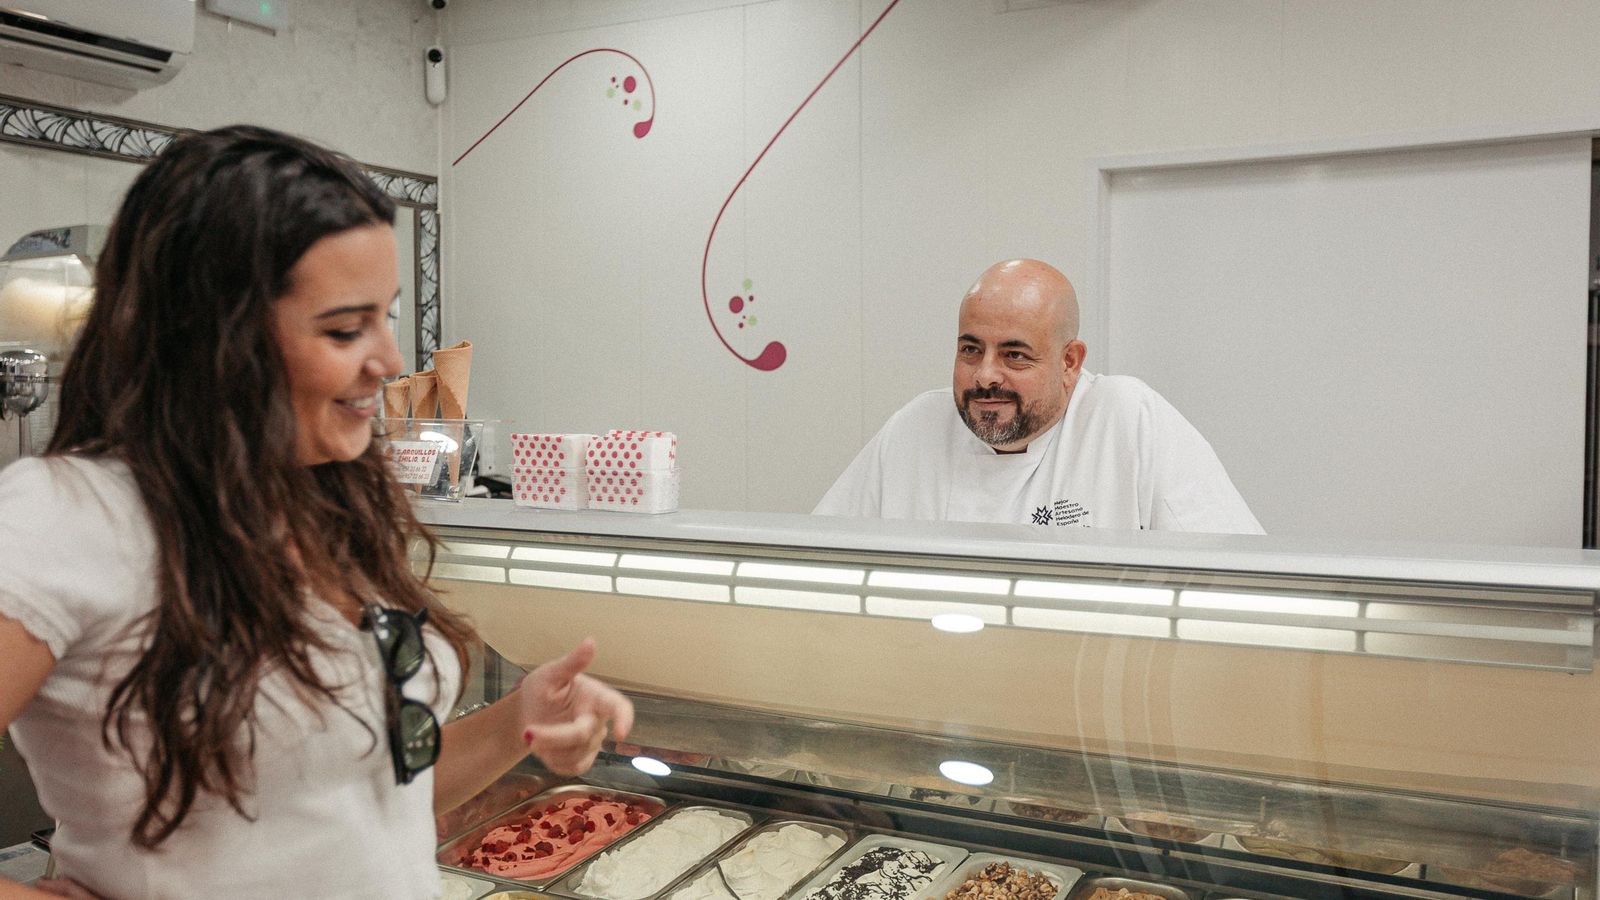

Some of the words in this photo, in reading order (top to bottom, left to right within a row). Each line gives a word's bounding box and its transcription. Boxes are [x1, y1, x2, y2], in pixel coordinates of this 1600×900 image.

[1055, 502, 1079, 511] Maestro
[1055, 507, 1083, 516] Artesano
[1056, 513, 1081, 521] Heladero
